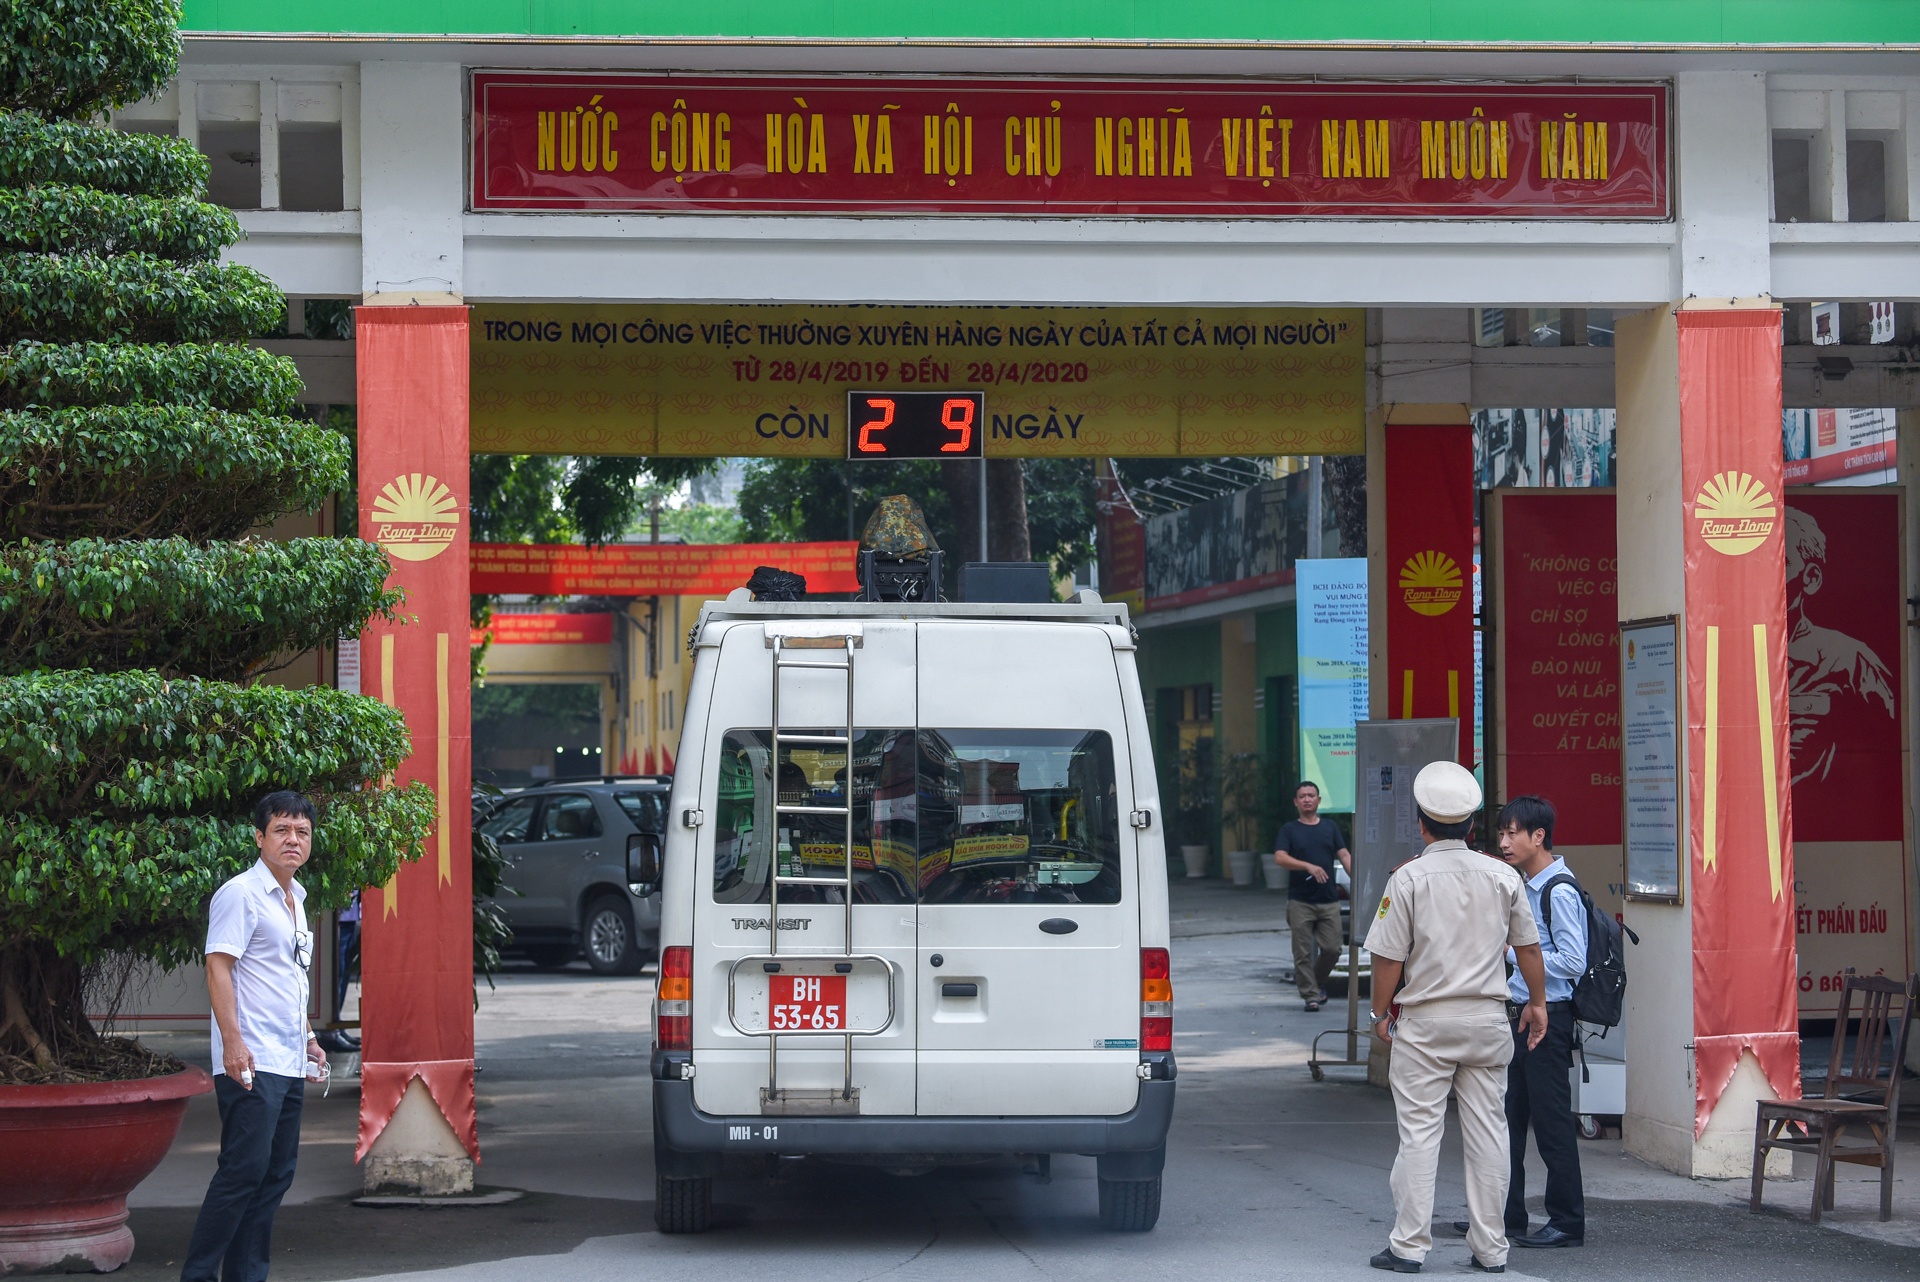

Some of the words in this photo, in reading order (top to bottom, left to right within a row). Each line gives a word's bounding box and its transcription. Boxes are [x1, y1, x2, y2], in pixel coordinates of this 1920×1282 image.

[537, 95, 619, 173] NƯỚC
[650, 98, 732, 184] CỘNG
[766, 97, 828, 175] HÒA
[852, 104, 895, 175] XÃ
[923, 103, 973, 188] HỘI
[1005, 100, 1063, 177] CHỦ
[1095, 107, 1194, 178] NGHĨA
[1221, 105, 1294, 189] VIỆT
[1321, 119, 1391, 180] NAM
[1420, 107, 1509, 181] MUÔN
[1540, 113, 1609, 181] NĂM
[484, 320, 562, 343] TRONG
[572, 321, 617, 349] MỌI
[621, 319, 694, 345] CÔNG
[700, 319, 752, 350] VIỆC
[757, 319, 852, 346] THƯỜNG
[857, 320, 930, 347] XUYÊN
[935, 320, 1001, 347] HÀNG
[1009, 320, 1074, 347] NGÀY
[1087, 319, 1127, 347] CỦA
[1134, 319, 1168, 346] TẤT
[1173, 319, 1207, 346] CẢ
[1213, 325, 1256, 350] MỌI
[732, 356, 762, 383] TỪ
[769, 360, 889, 385] 28/4/2019
[900, 354, 949, 384] ĐẾN
[967, 361, 1089, 386] 28/4/2020
[755, 405, 829, 439] CÒN
[992, 406, 1084, 440] NGÀY
[1557, 577, 1595, 598] VIỆC
[1530, 604, 1562, 623] CHỈ
[1563, 608, 1589, 627] SỢ
[1558, 629, 1605, 647] LÒNG
[1531, 656, 1568, 675] ĐÀO
[1572, 656, 1602, 675] NÚI
[1556, 680, 1578, 698] VÀ
[1583, 678, 1616, 698] LẤP
[1532, 707, 1591, 728] QUYẾT
[1591, 772, 1622, 786] Bác
[1794, 903, 1812, 934] ẾT
[1817, 901, 1855, 934] PHẤN
[1859, 901, 1887, 934] ĐẤU
[793, 977, 821, 1002] BH
[1820, 970, 1843, 992] BÁ
[773, 1005, 839, 1029] 53-65
[730, 1126, 750, 1140] MH
[763, 1126, 778, 1140] 01
